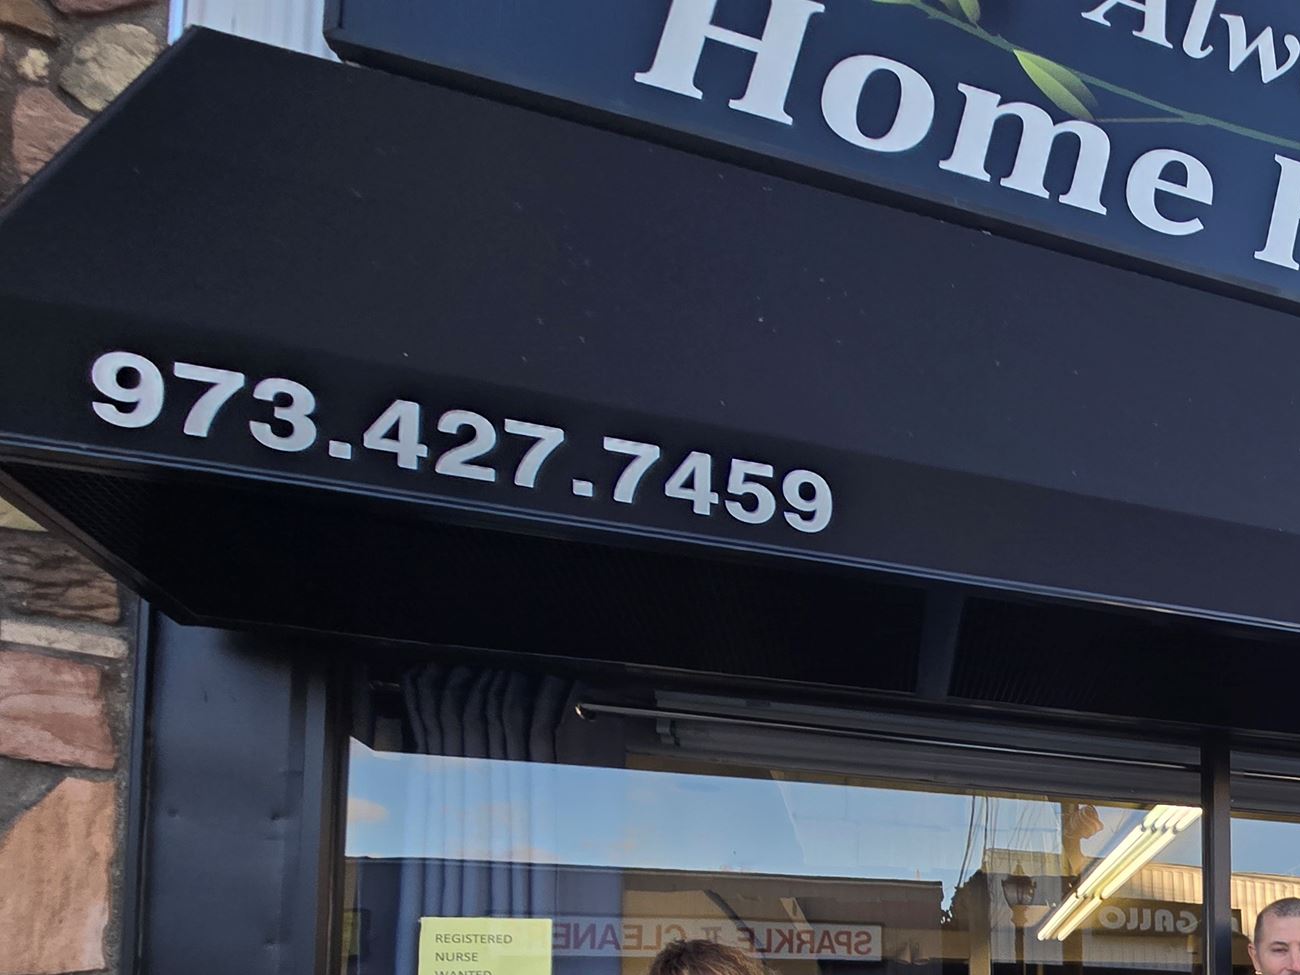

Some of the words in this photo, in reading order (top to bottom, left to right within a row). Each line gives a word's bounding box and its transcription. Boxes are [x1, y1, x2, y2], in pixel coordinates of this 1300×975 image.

[634, 0, 1214, 237] Home
[90, 350, 834, 533] 973.427.7459
[435, 933, 513, 945] REGISTERED
[435, 952, 479, 962] NURSE
